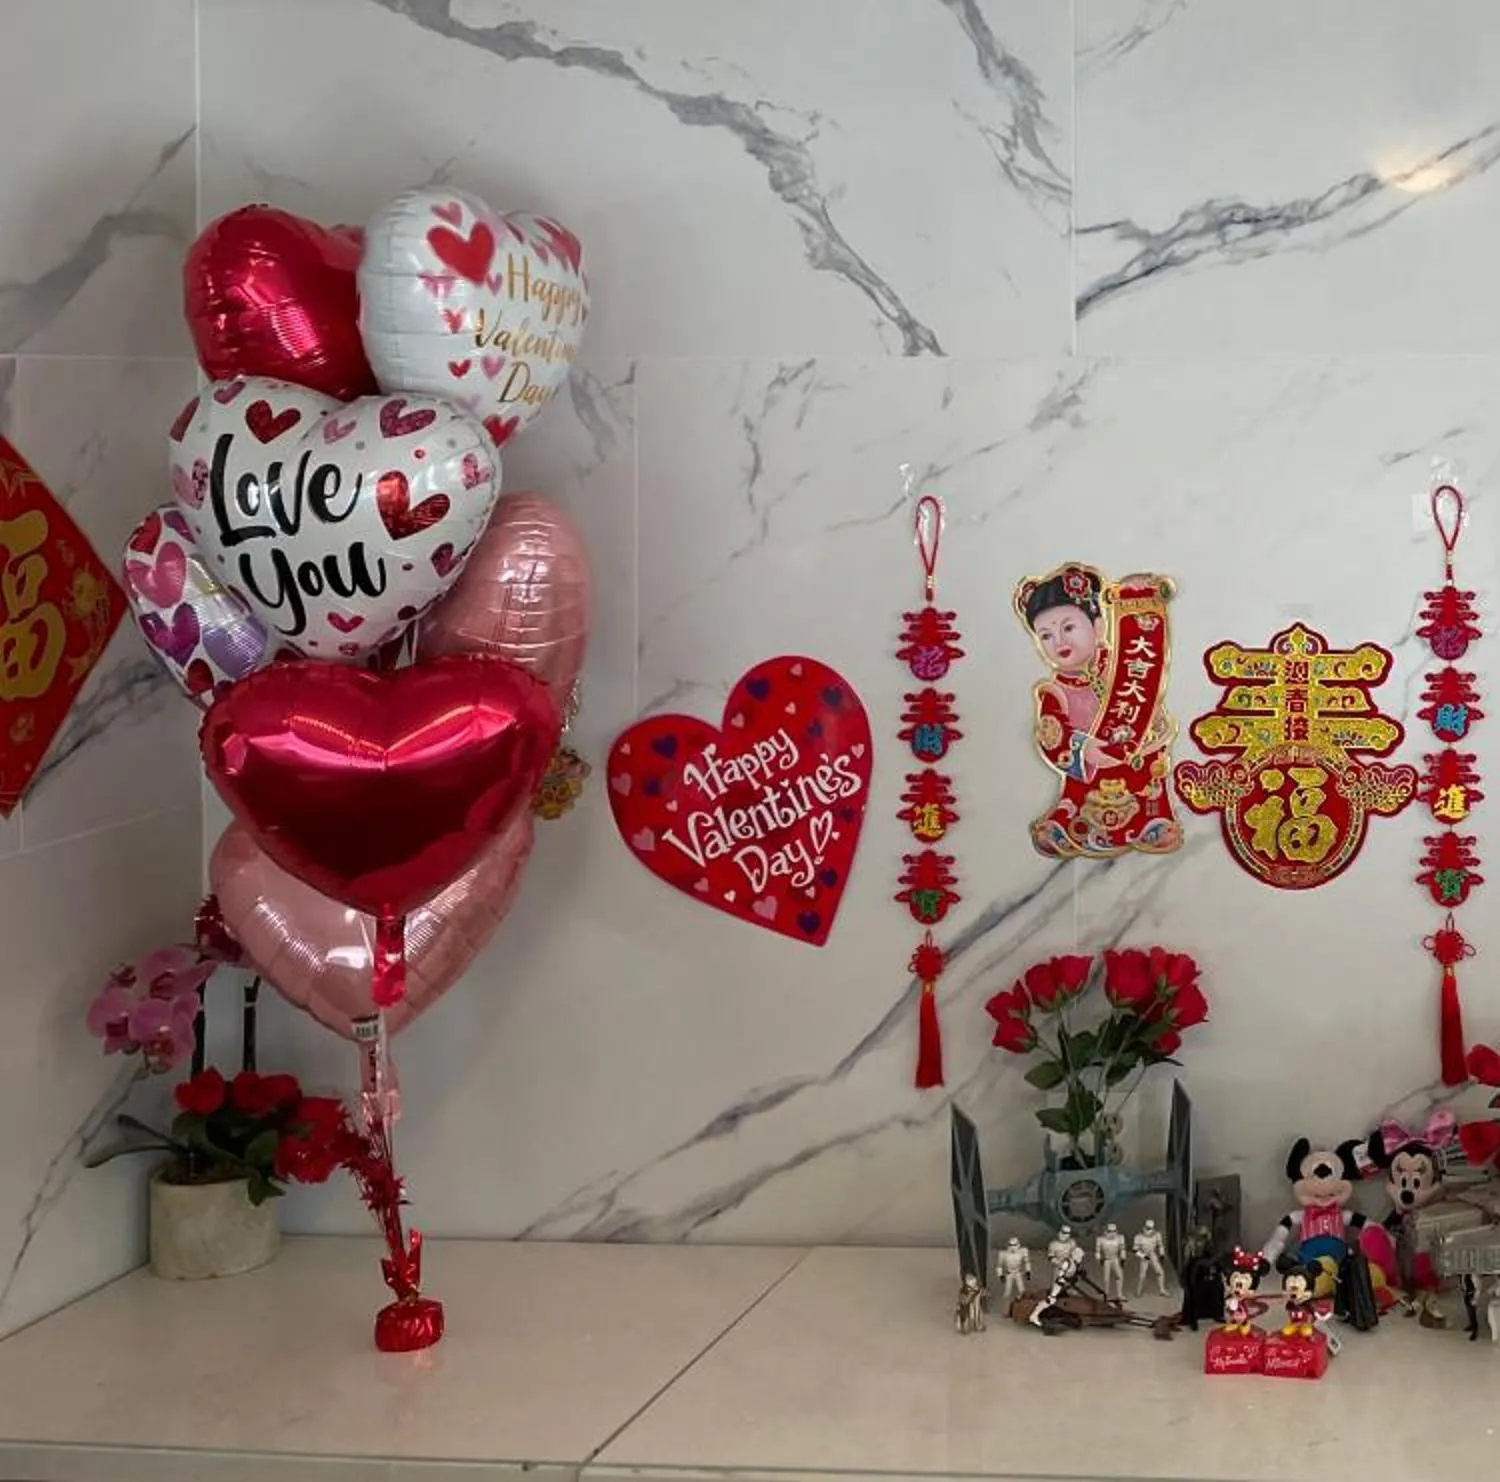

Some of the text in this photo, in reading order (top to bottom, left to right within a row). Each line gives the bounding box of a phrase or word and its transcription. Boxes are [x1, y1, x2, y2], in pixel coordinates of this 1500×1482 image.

[507, 252, 582, 327] Happy
[209, 433, 362, 547] Love
[239, 541, 387, 636] You
[1109, 635, 1157, 725] 大吉大利
[661, 753, 862, 868] Valentine's
[683, 727, 800, 801] Happy
[1243, 767, 1339, 864] 福
